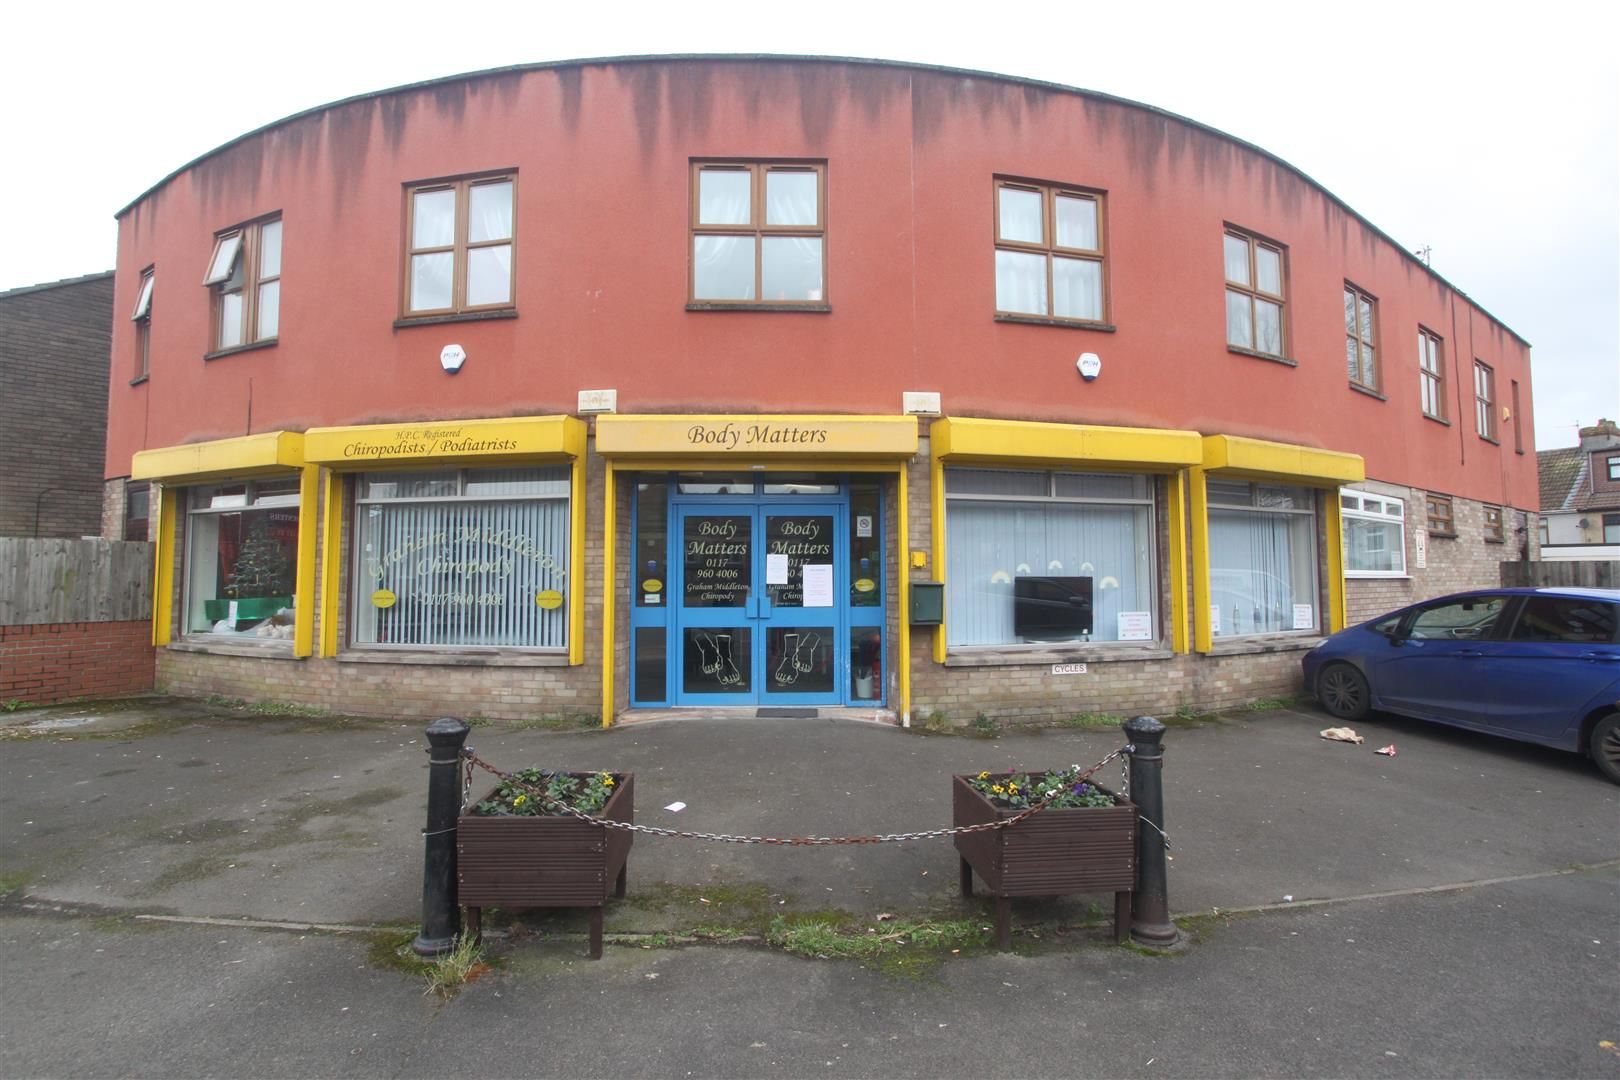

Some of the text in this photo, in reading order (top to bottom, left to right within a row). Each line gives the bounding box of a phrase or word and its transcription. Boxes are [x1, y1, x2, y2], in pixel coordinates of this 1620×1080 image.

[687, 423, 828, 450] Body Matters
[344, 439, 426, 458] Chiropodists
[440, 437, 518, 452] Podiatrists
[688, 519, 748, 555] Body Matters
[781, 519, 820, 540] Body
[771, 540, 830, 555] Matters
[416, 555, 514, 580] Chiropody
[706, 558, 729, 568] 0117
[697, 569, 739, 578] 960 4006
[687, 582, 713, 592] Graham
[701, 591, 735, 602] Chiropody
[1054, 664, 1085, 673] CYCLES
